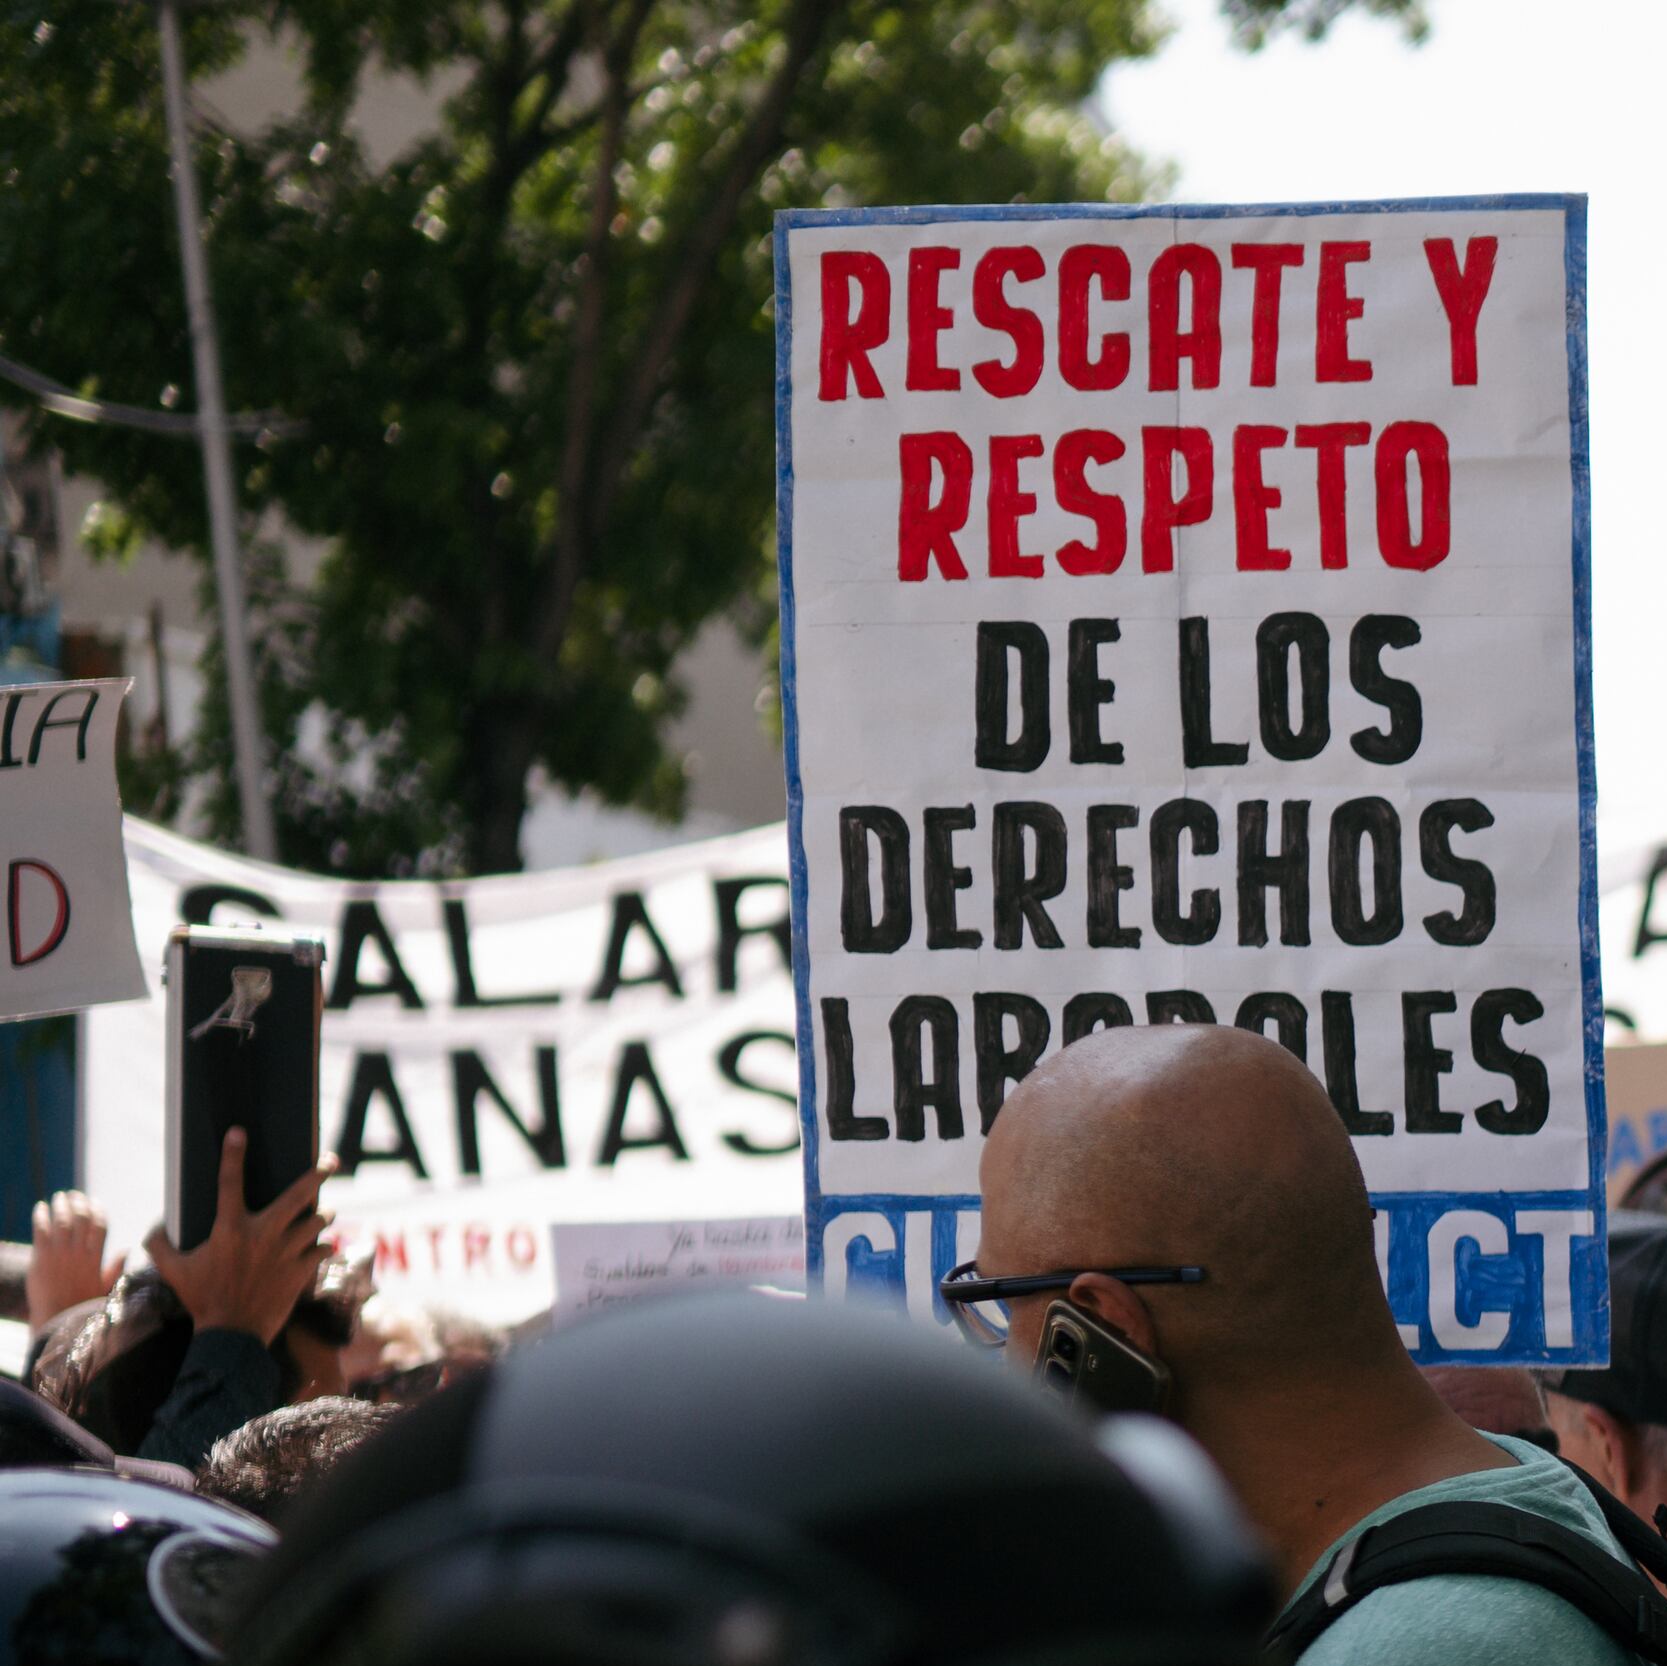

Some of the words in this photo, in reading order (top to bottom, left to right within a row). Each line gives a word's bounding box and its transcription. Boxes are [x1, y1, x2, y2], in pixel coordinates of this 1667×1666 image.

[819, 239, 1374, 402] RESCATE
[1422, 235, 1498, 386] Y
[897, 420, 1452, 583] RESPETO
[973, 617, 1125, 774] DE
[1177, 610, 1424, 770] LOS
[838, 795, 1498, 955] DERECHOS
[820, 988, 1550, 1141] LABLES
